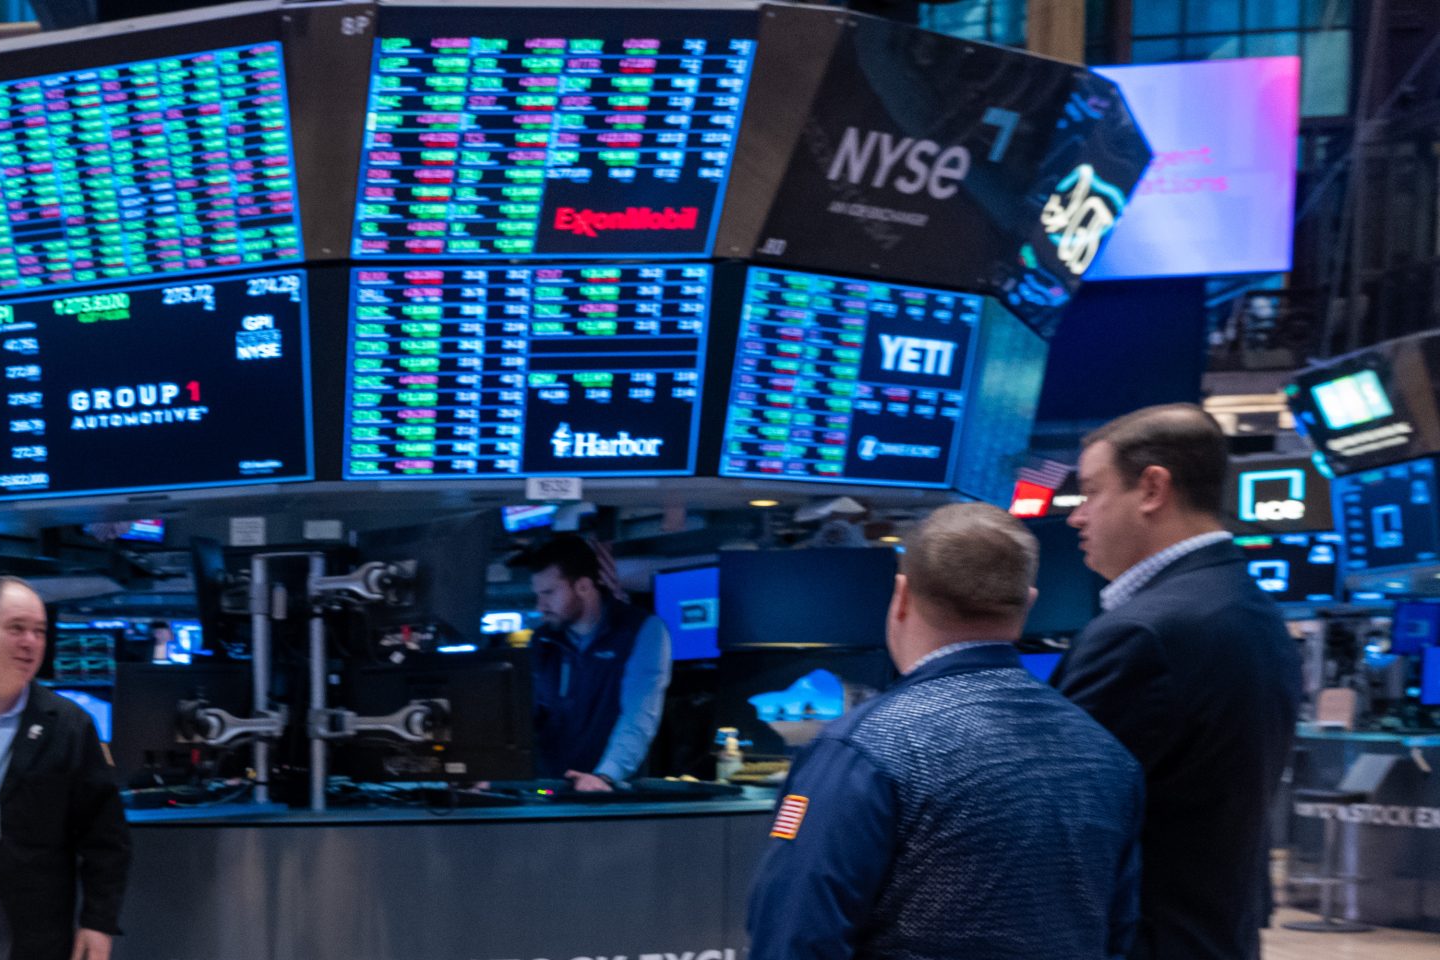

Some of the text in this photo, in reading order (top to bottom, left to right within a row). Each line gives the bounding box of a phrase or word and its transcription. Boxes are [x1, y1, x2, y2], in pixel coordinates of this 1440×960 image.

[879, 333, 958, 376] YETI
[69, 382, 180, 411] GROUP
[186, 380, 201, 402] 1
[70, 408, 201, 430] AUTOMOTIVE
[573, 431, 663, 457] Harbor
